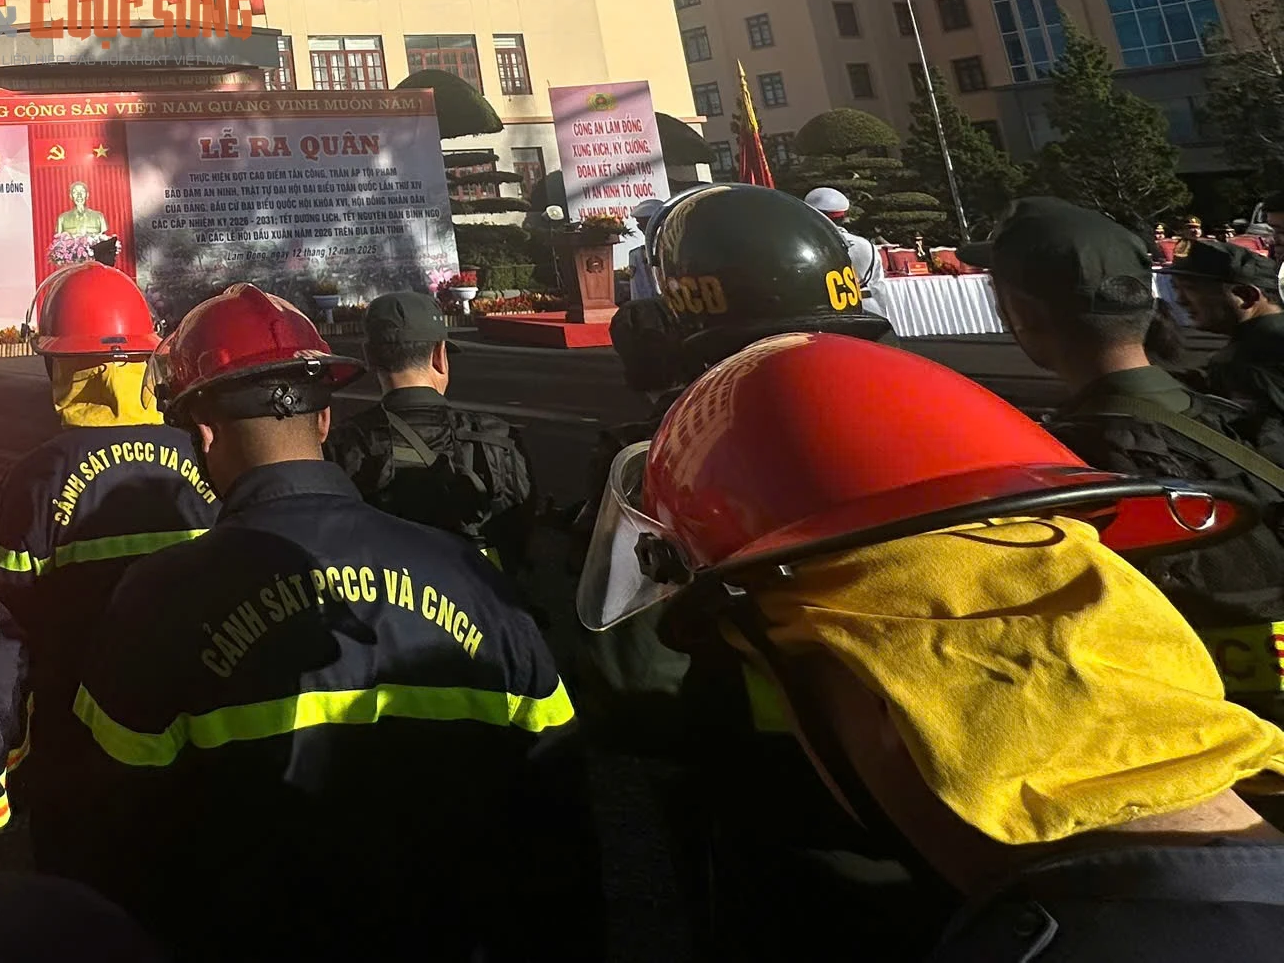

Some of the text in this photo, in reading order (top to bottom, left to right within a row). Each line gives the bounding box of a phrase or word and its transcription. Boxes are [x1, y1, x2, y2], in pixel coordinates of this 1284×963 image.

[14, 102, 67, 120] CỘNG
[71, 98, 108, 116] SẢN
[114, 98, 156, 117] VIỆT
[161, 101, 203, 114] NAM
[208, 100, 270, 114] QUANG
[275, 98, 317, 111] VINH
[324, 96, 372, 111] MUÔN
[573, 115, 642, 136] CÔNG AN LÂM ĐỒNG
[199, 127, 381, 160] LỄ RA QUÂN
[572, 144, 592, 158] XUNG
[249, 171, 265, 180] CAO
[616, 159, 636, 176] SÁNG
[203, 188, 214, 197] AN
[410, 181, 422, 190] XIV
[582, 183, 591, 199] VÌ
[591, 185, 601, 198] AN
[602, 184, 620, 198] NINH
[621, 177, 631, 197] TỔ
[314, 227, 332, 237] 2026
[292, 245, 377, 258] 12 12 2025
[52, 473, 87, 526] CẢNH
[79, 450, 113, 481] SÁT
[110, 441, 156, 465] PCCC
[159, 445, 180, 471] VÀ
[201, 565, 484, 678] CẢNH SÁT PCCC VÀ CNCH
